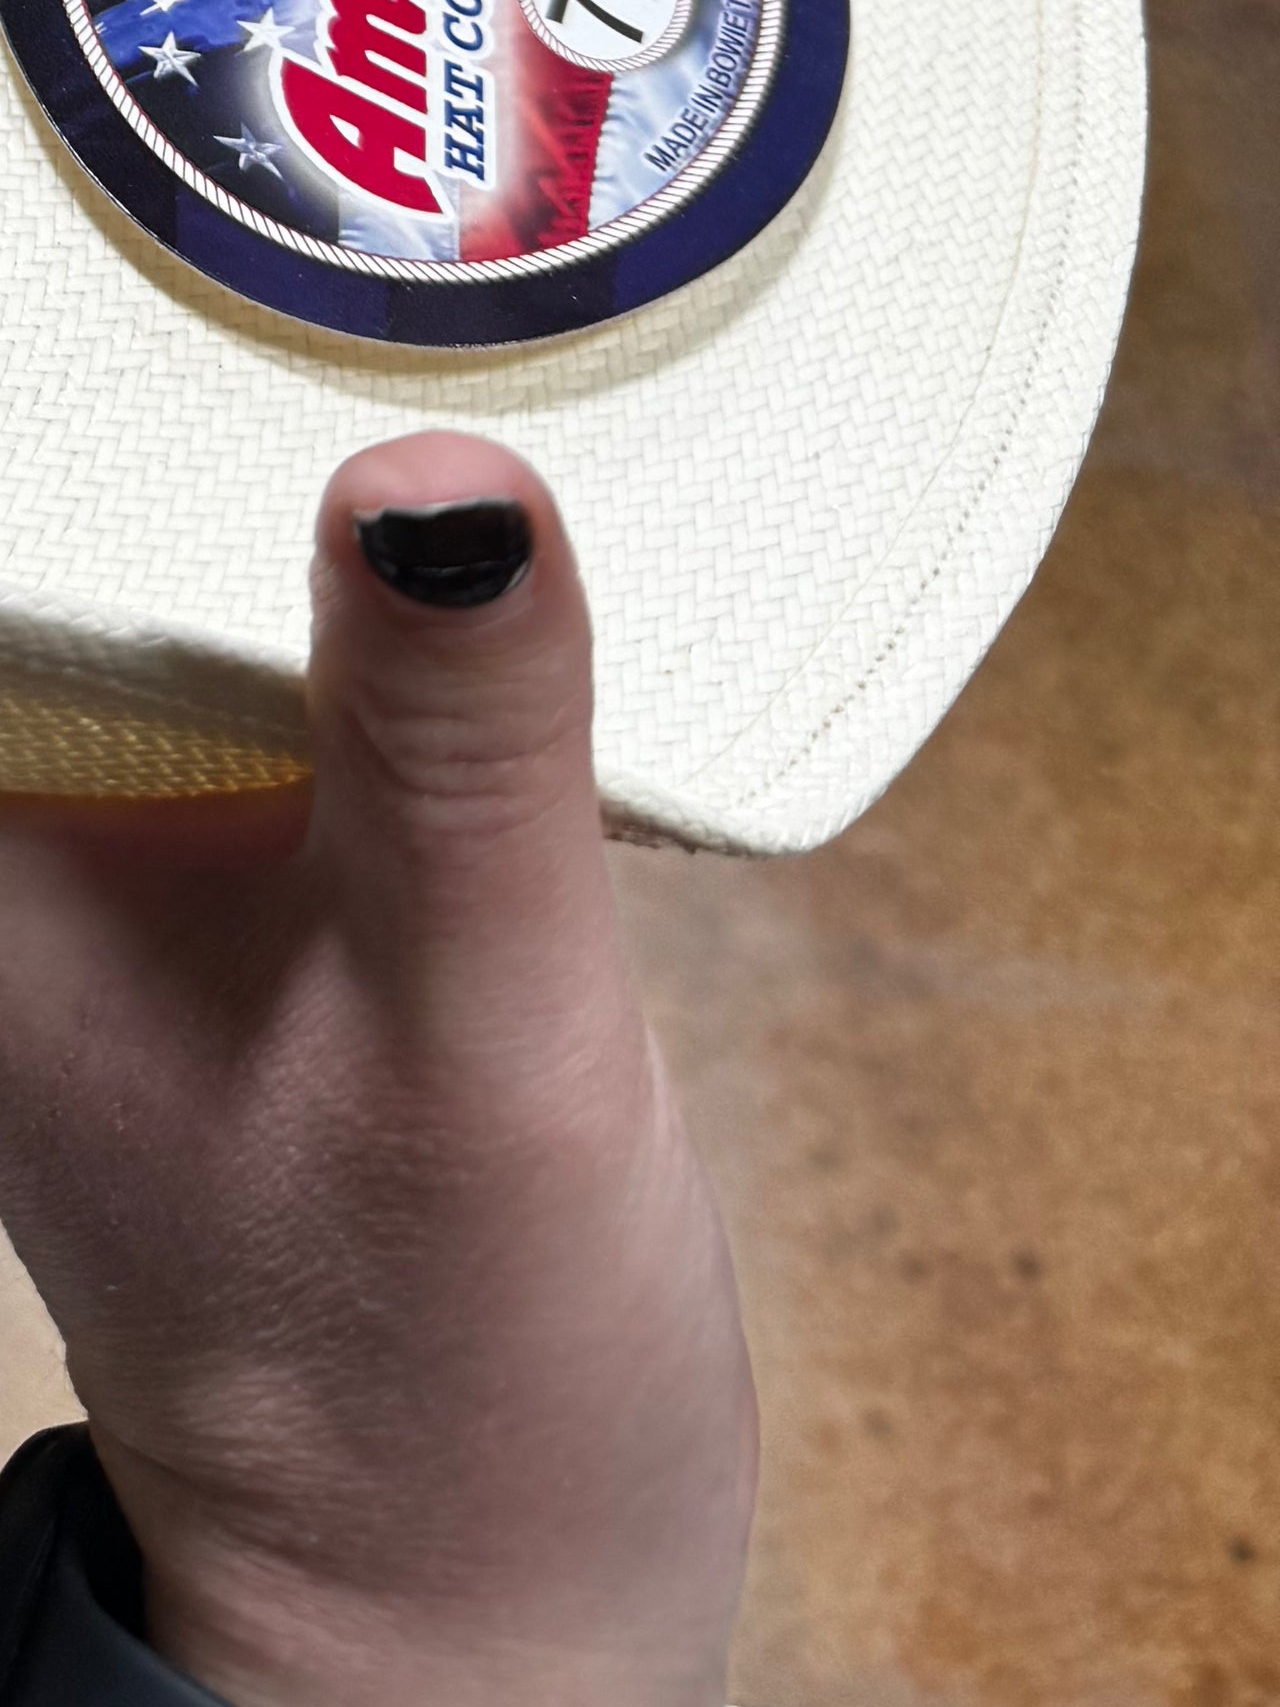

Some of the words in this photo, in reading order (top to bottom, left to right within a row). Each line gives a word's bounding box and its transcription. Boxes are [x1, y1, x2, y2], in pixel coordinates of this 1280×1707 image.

[705, 11, 749, 89] BOWIE
[443, 59, 486, 181] HAT
[690, 84, 724, 114] IN
[643, 107, 709, 172] MADE
